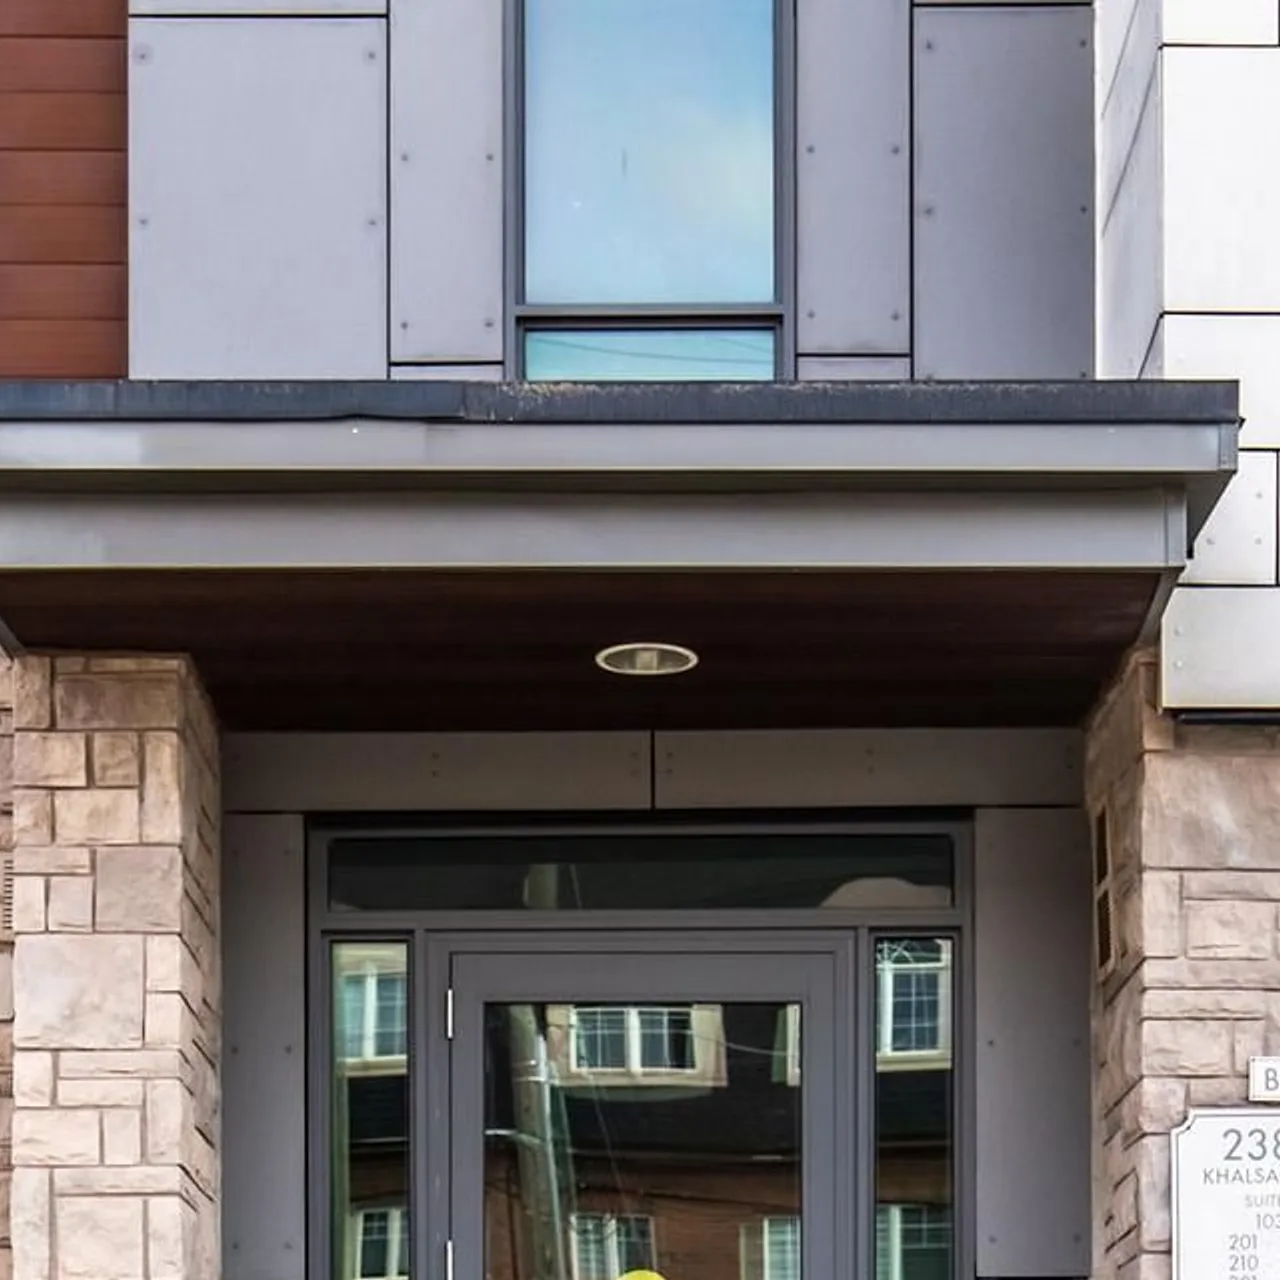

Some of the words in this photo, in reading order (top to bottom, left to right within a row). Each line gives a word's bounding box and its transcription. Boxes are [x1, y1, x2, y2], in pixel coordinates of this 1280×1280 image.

[1265, 1068, 1279, 1091] B
[1202, 1167, 1280, 1184] KHALSA
[1228, 1233, 1258, 1250] 201
[1228, 1254, 1259, 1271] 210
